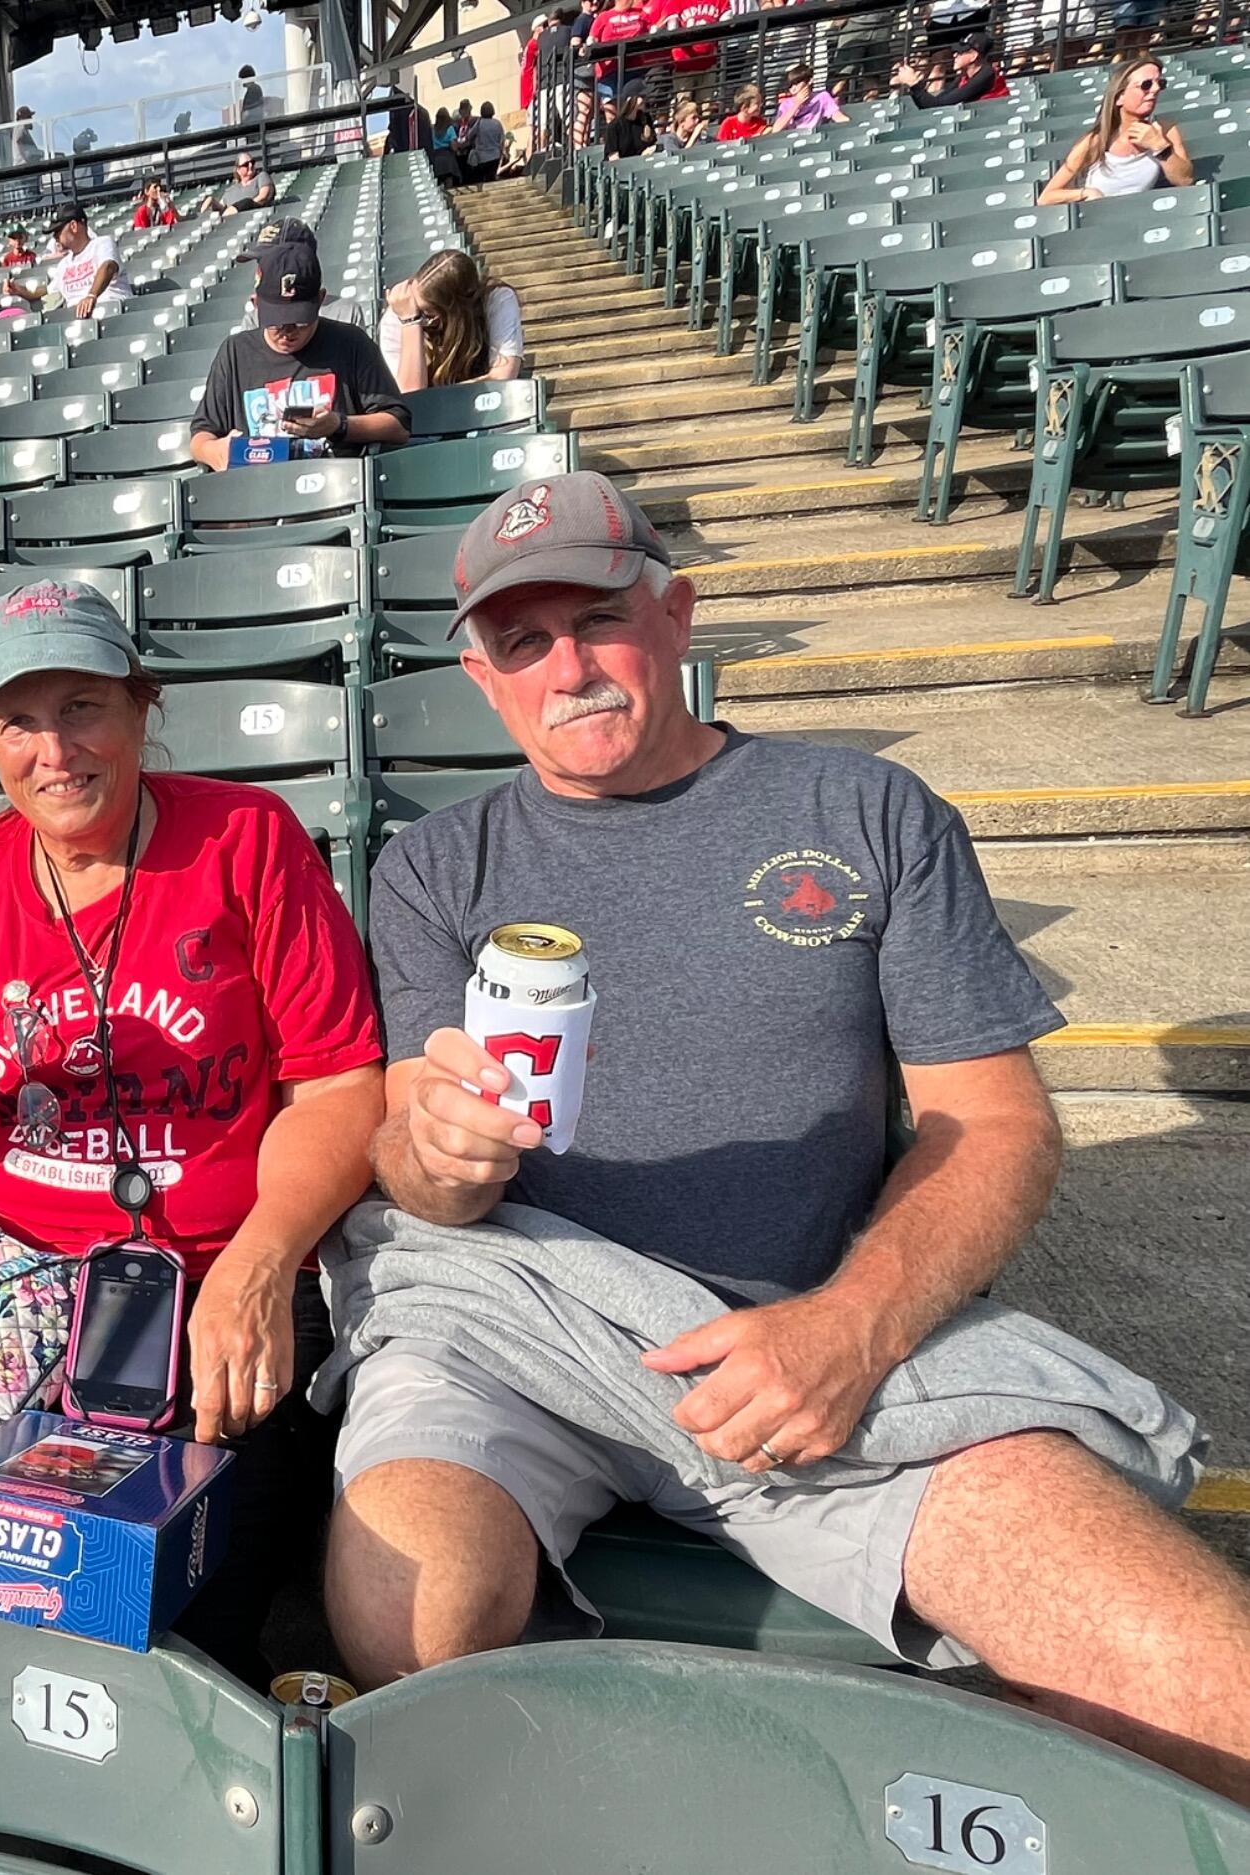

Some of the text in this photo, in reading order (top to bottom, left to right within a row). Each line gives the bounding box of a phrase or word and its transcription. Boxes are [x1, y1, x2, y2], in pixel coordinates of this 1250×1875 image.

[281, 273, 297, 298] C
[481, 395, 495, 409] 16
[500, 453, 517, 466] 16
[302, 477, 318, 491] 15
[286, 568, 303, 583] 15
[251, 709, 273, 730] 15
[746, 849, 862, 890] MILLION DOLLAR
[754, 910, 866, 947] COWBOY BAR
[175, 928, 215, 983] C
[527, 985, 572, 1005] Miller
[12, 1151, 114, 1188] ESTABLISHE
[39, 1682, 91, 1741] 15
[923, 1793, 1007, 1866] 16
